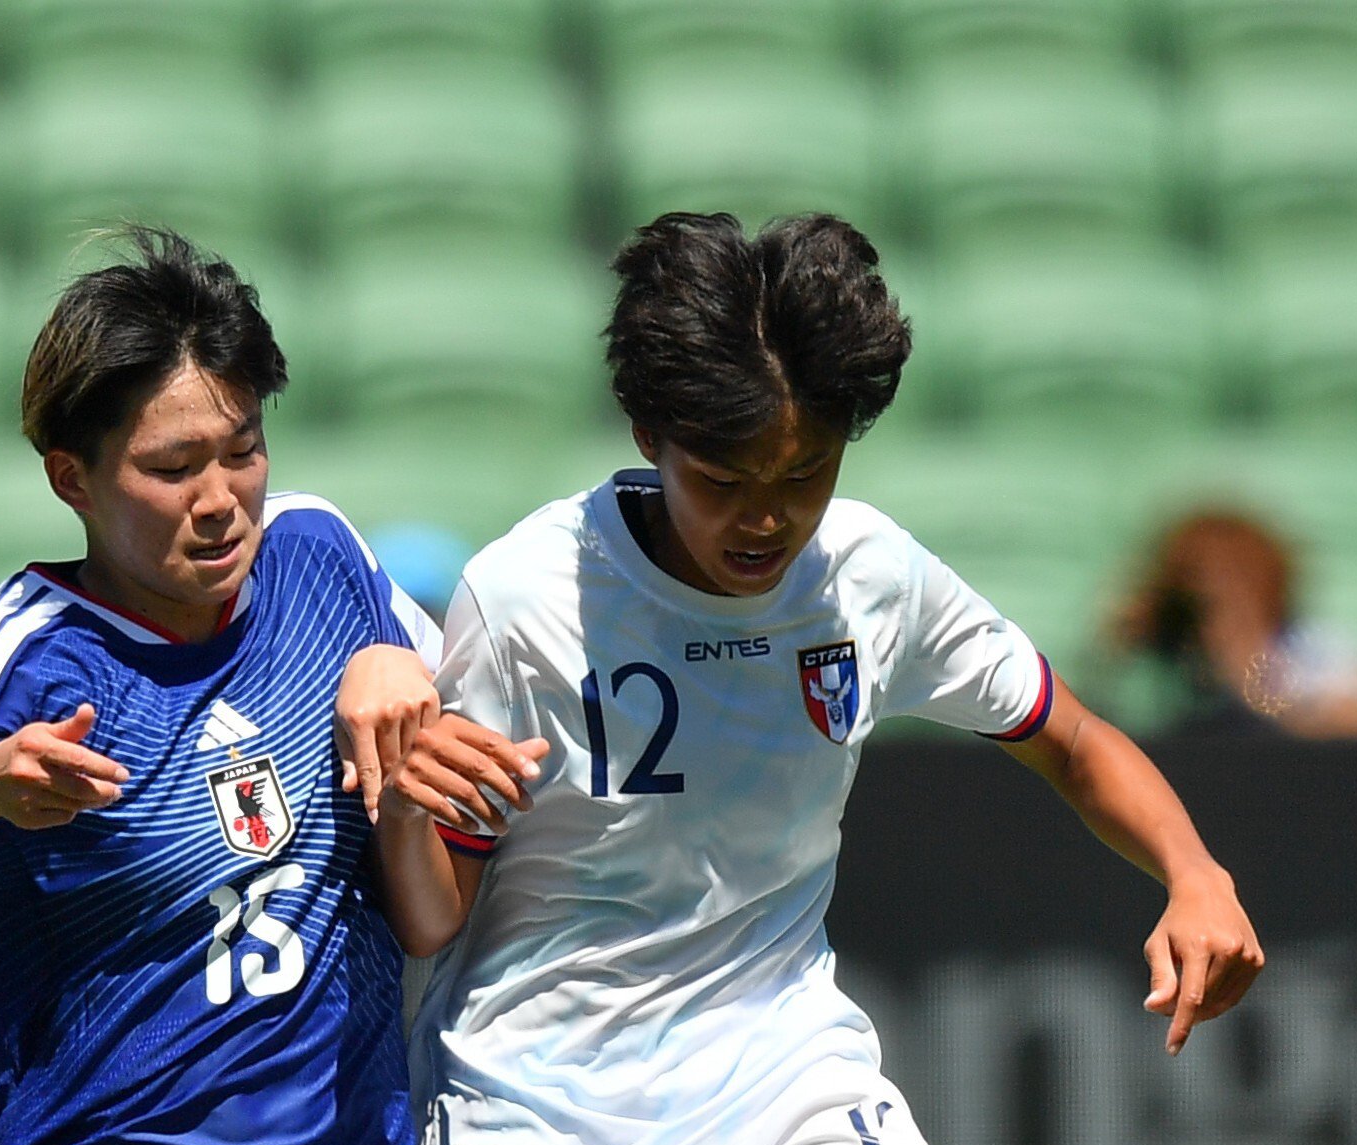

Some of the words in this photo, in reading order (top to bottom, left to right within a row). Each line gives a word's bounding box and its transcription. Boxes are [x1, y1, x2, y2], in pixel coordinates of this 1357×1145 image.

[685, 637, 771, 662] ENTES
[805, 646, 851, 667] CTFA
[581, 661, 684, 797] 12
[223, 763, 258, 781] JAPAN
[206, 863, 305, 1005] 15
